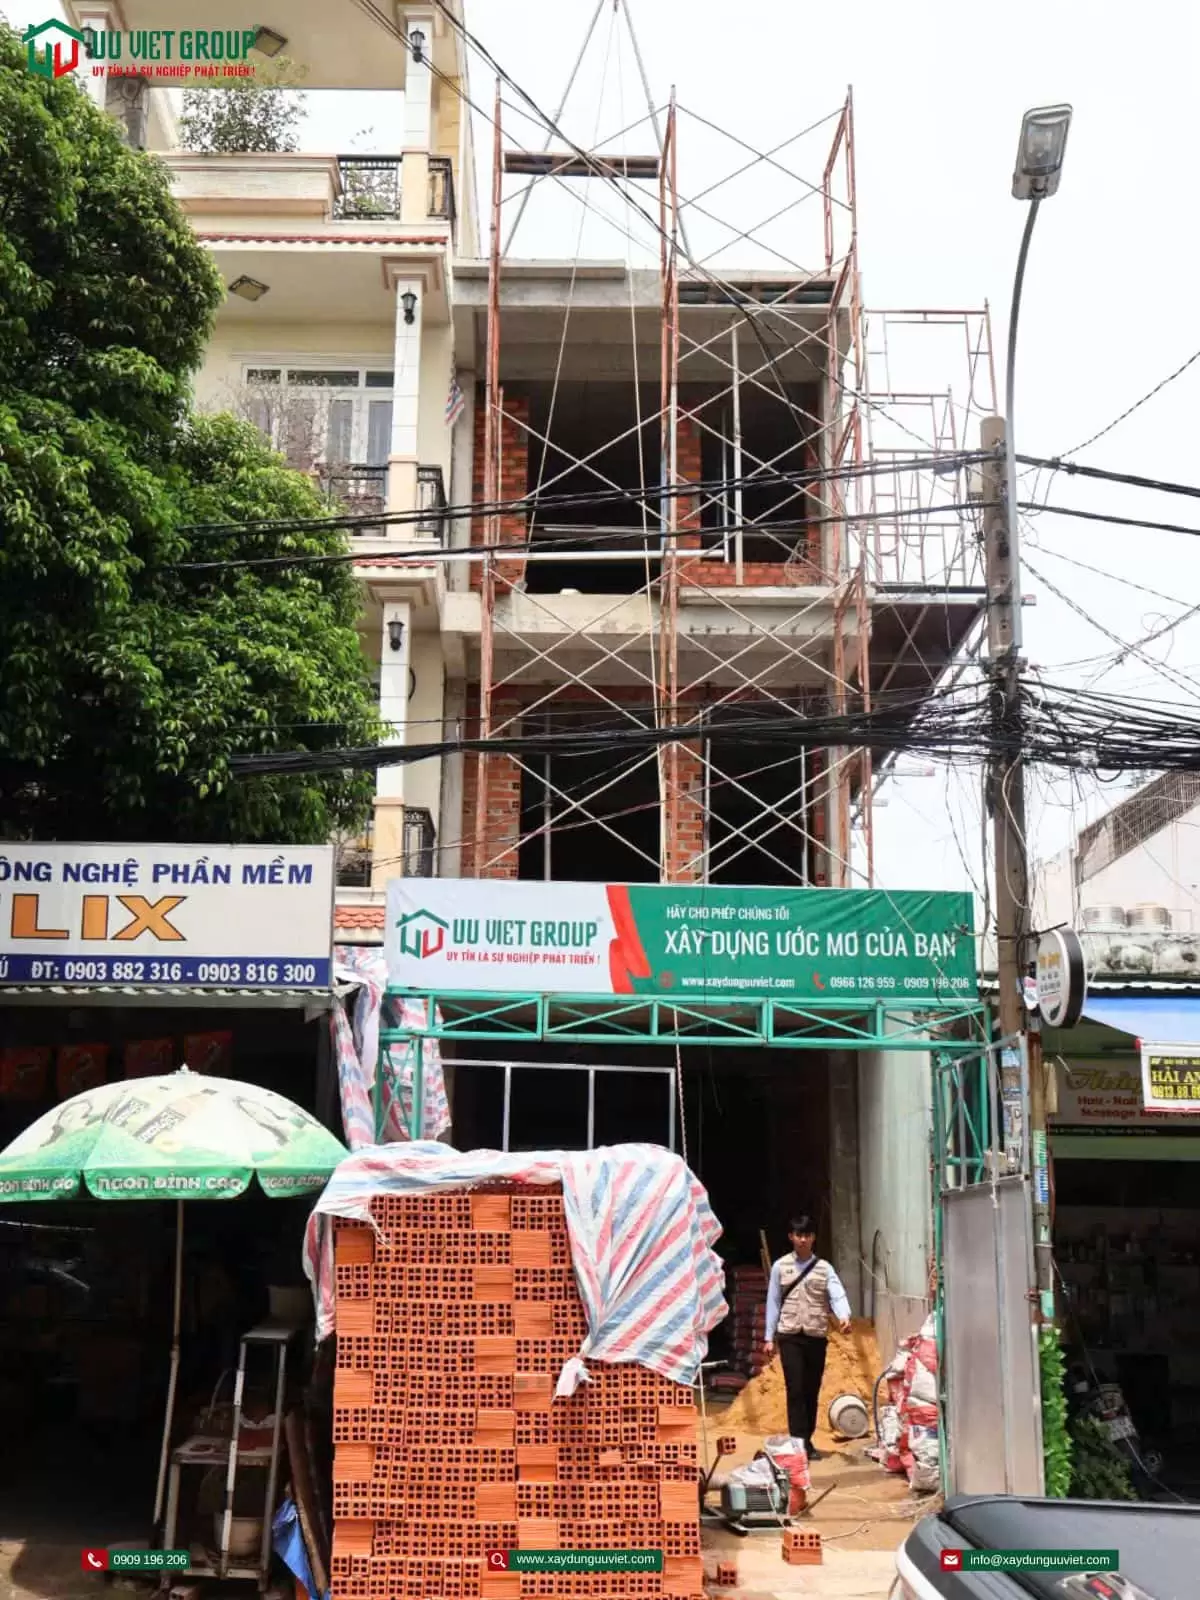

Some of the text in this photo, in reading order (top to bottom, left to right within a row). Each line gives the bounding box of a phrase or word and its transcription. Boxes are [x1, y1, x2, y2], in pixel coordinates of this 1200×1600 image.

[62, 858, 140, 887] NGHỆ
[152, 855, 231, 884] PHẦN
[242, 855, 313, 885] MỀM
[688, 907, 709, 919] CHO
[711, 904, 736, 919] PHÉP
[738, 905, 772, 920] CHÚNG
[774, 905, 790, 920] TÔI
[486, 920, 526, 946] VIET
[530, 921, 597, 947] GROUP
[664, 924, 957, 962] XÂY DỰNG ƯỚC MƠ CỦA BẠN
[446, 952, 459, 961] UY
[31, 961, 59, 980] ĐT:
[65, 962, 106, 980] 0903
[112, 962, 144, 980] 882
[151, 963, 182, 981] 316
[198, 963, 239, 981] 0903
[246, 963, 278, 982] 816
[283, 963, 316, 982] 300
[830, 977, 855, 989] 0966
[858, 977, 876, 989] 126
[877, 977, 896, 989] 959
[904, 978, 930, 989] 0909
